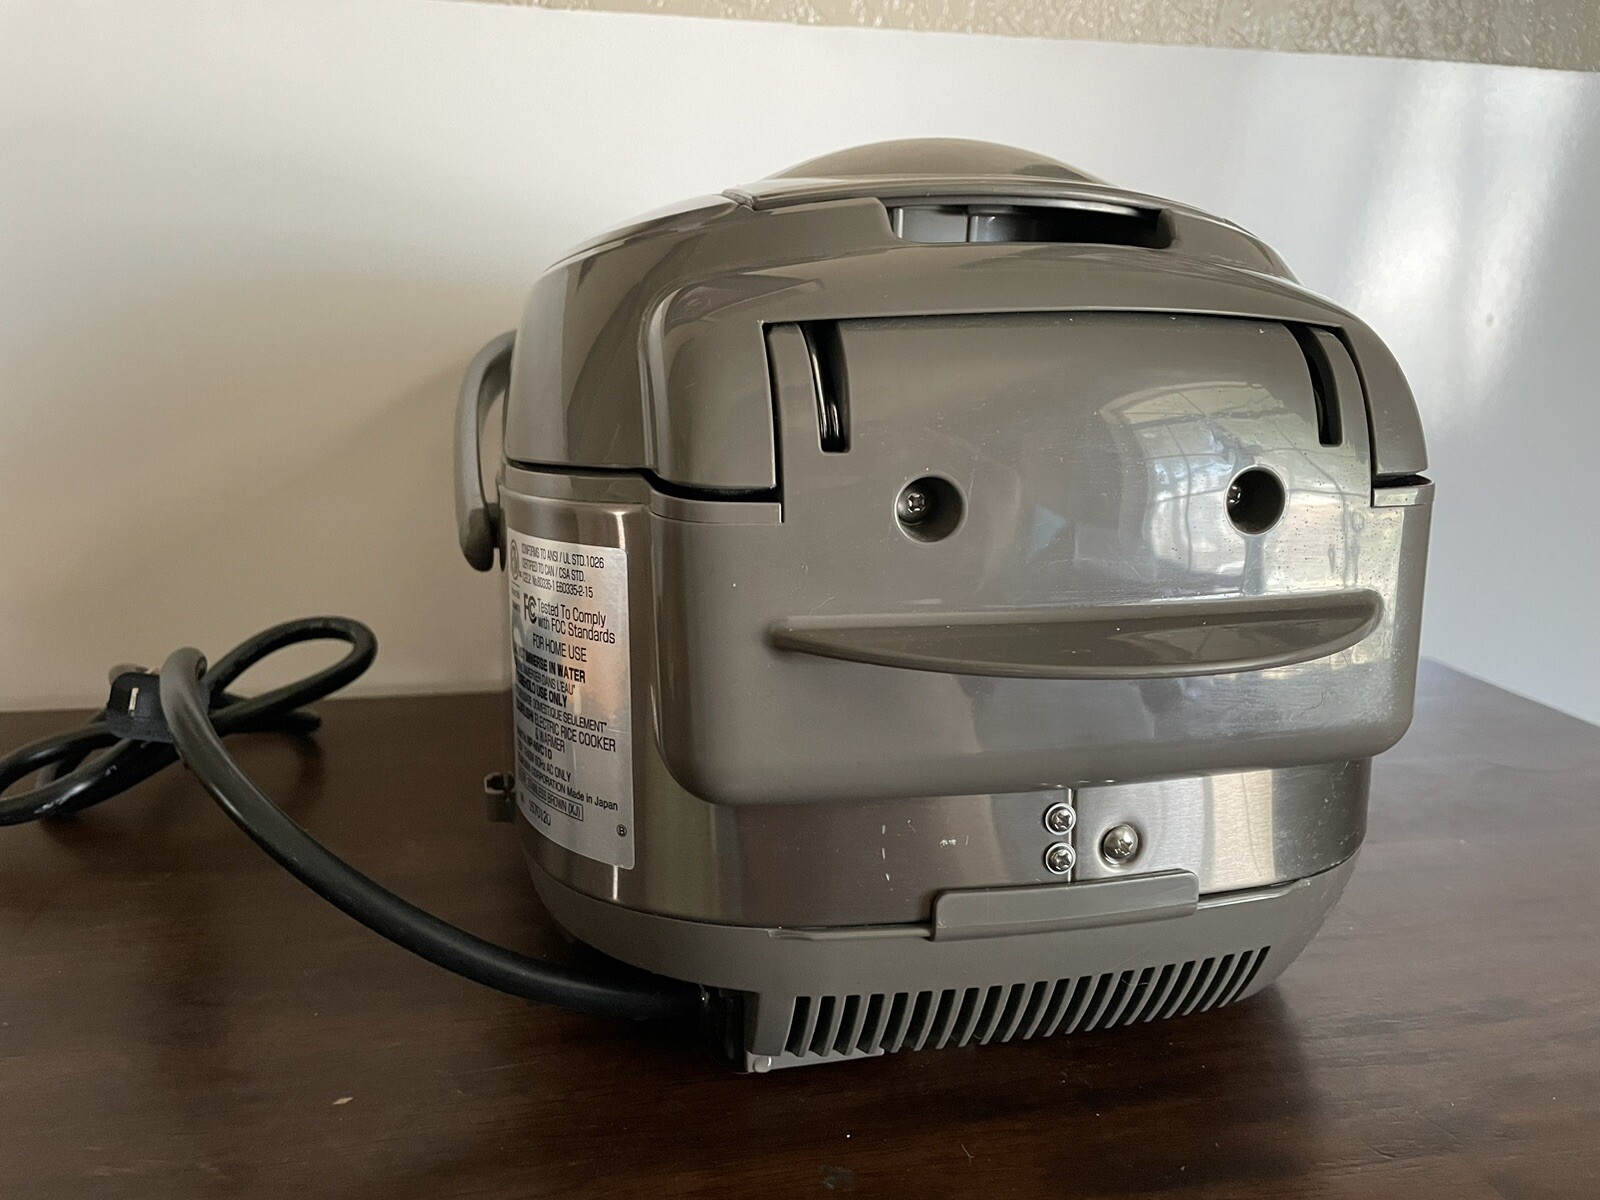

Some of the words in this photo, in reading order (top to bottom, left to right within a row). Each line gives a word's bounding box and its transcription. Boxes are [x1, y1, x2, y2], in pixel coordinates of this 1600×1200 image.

[547, 549, 559, 563] ANSI
[563, 552, 571, 565] UL
[545, 563, 555, 577] CAN
[559, 567, 571, 580] CSA
[571, 569, 586, 582] STD.
[537, 598, 559, 618] Tested
[560, 604, 571, 620] To
[572, 607, 606, 628] Comply
[538, 615, 550, 631] with
[551, 618, 566, 635] FCC
[568, 622, 616, 644] Standards
[533, 633, 545, 651] FOR
[545, 636, 567, 658] HOME
[568, 645, 587, 662] USE
[548, 660, 557, 675] IN
[557, 663, 586, 684] WATER
[536, 684, 548, 701] USE
[549, 691, 568, 708] ONLY
[534, 712, 560, 737] ELECTRIC
[560, 724, 577, 743] RICE
[578, 731, 616, 752] COOKER
[540, 730, 565, 753] WARMER
[546, 762, 554, 776] AC
[555, 766, 571, 783] ONLY
[547, 792, 567, 812] BROWN
[566, 786, 585, 801] Made
[594, 796, 619, 811] Japan
